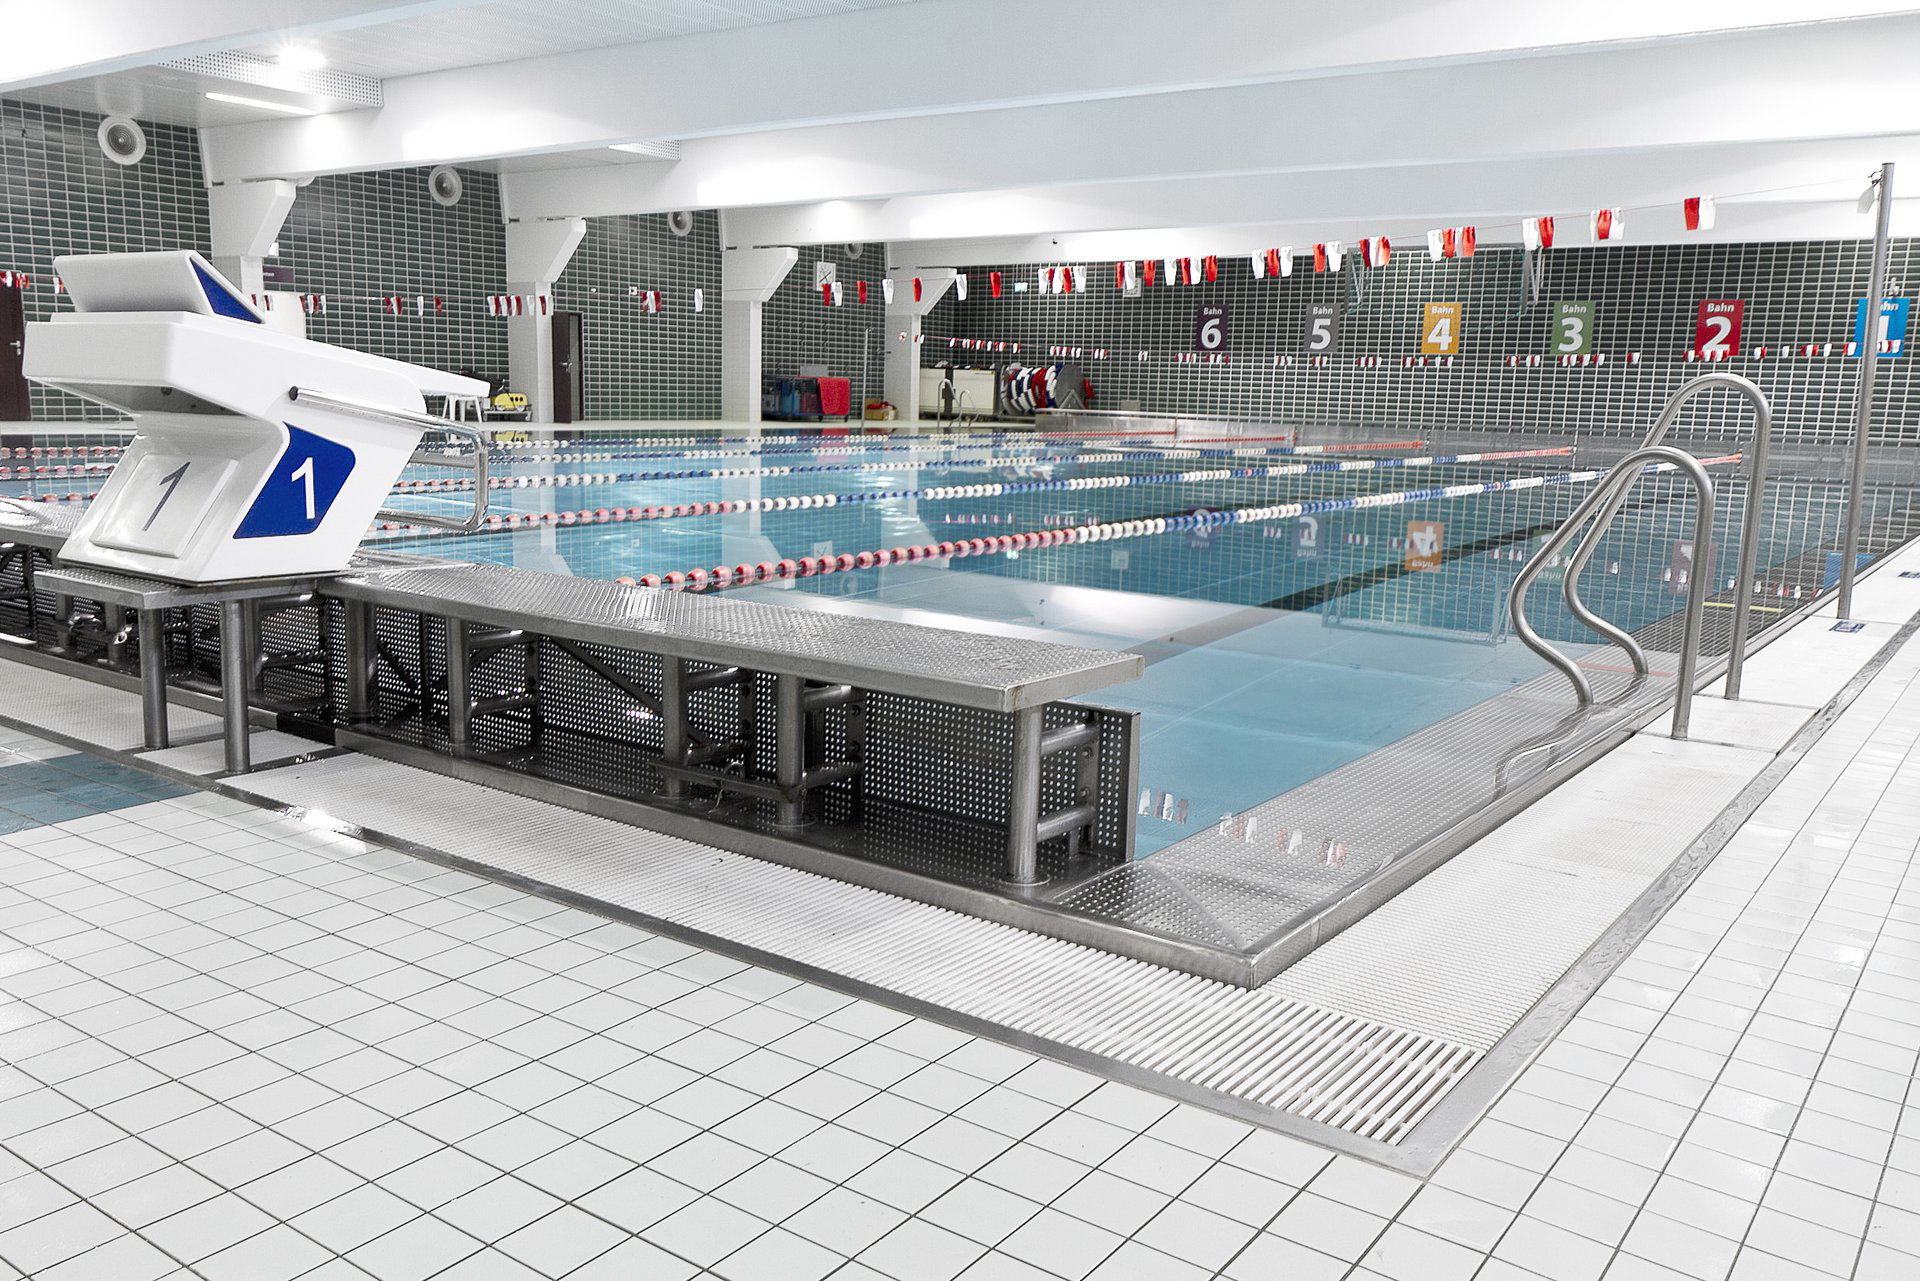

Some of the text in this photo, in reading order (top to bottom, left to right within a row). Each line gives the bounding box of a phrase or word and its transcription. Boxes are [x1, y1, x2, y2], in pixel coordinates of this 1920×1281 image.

[1203, 307, 1222, 315] Bahn
[1312, 306, 1333, 315] Bahn
[1431, 305, 1454, 314] Bahn
[1562, 304, 1587, 313] Bahn
[1707, 303, 1735, 312] Bahn
[1201, 318, 1222, 349] 6
[1310, 318, 1331, 349] 5
[1427, 318, 1453, 350] 4
[1557, 317, 1584, 352] 3
[1702, 316, 1731, 352] 2
[142, 461, 191, 531] 1
[291, 457, 316, 520] 1
